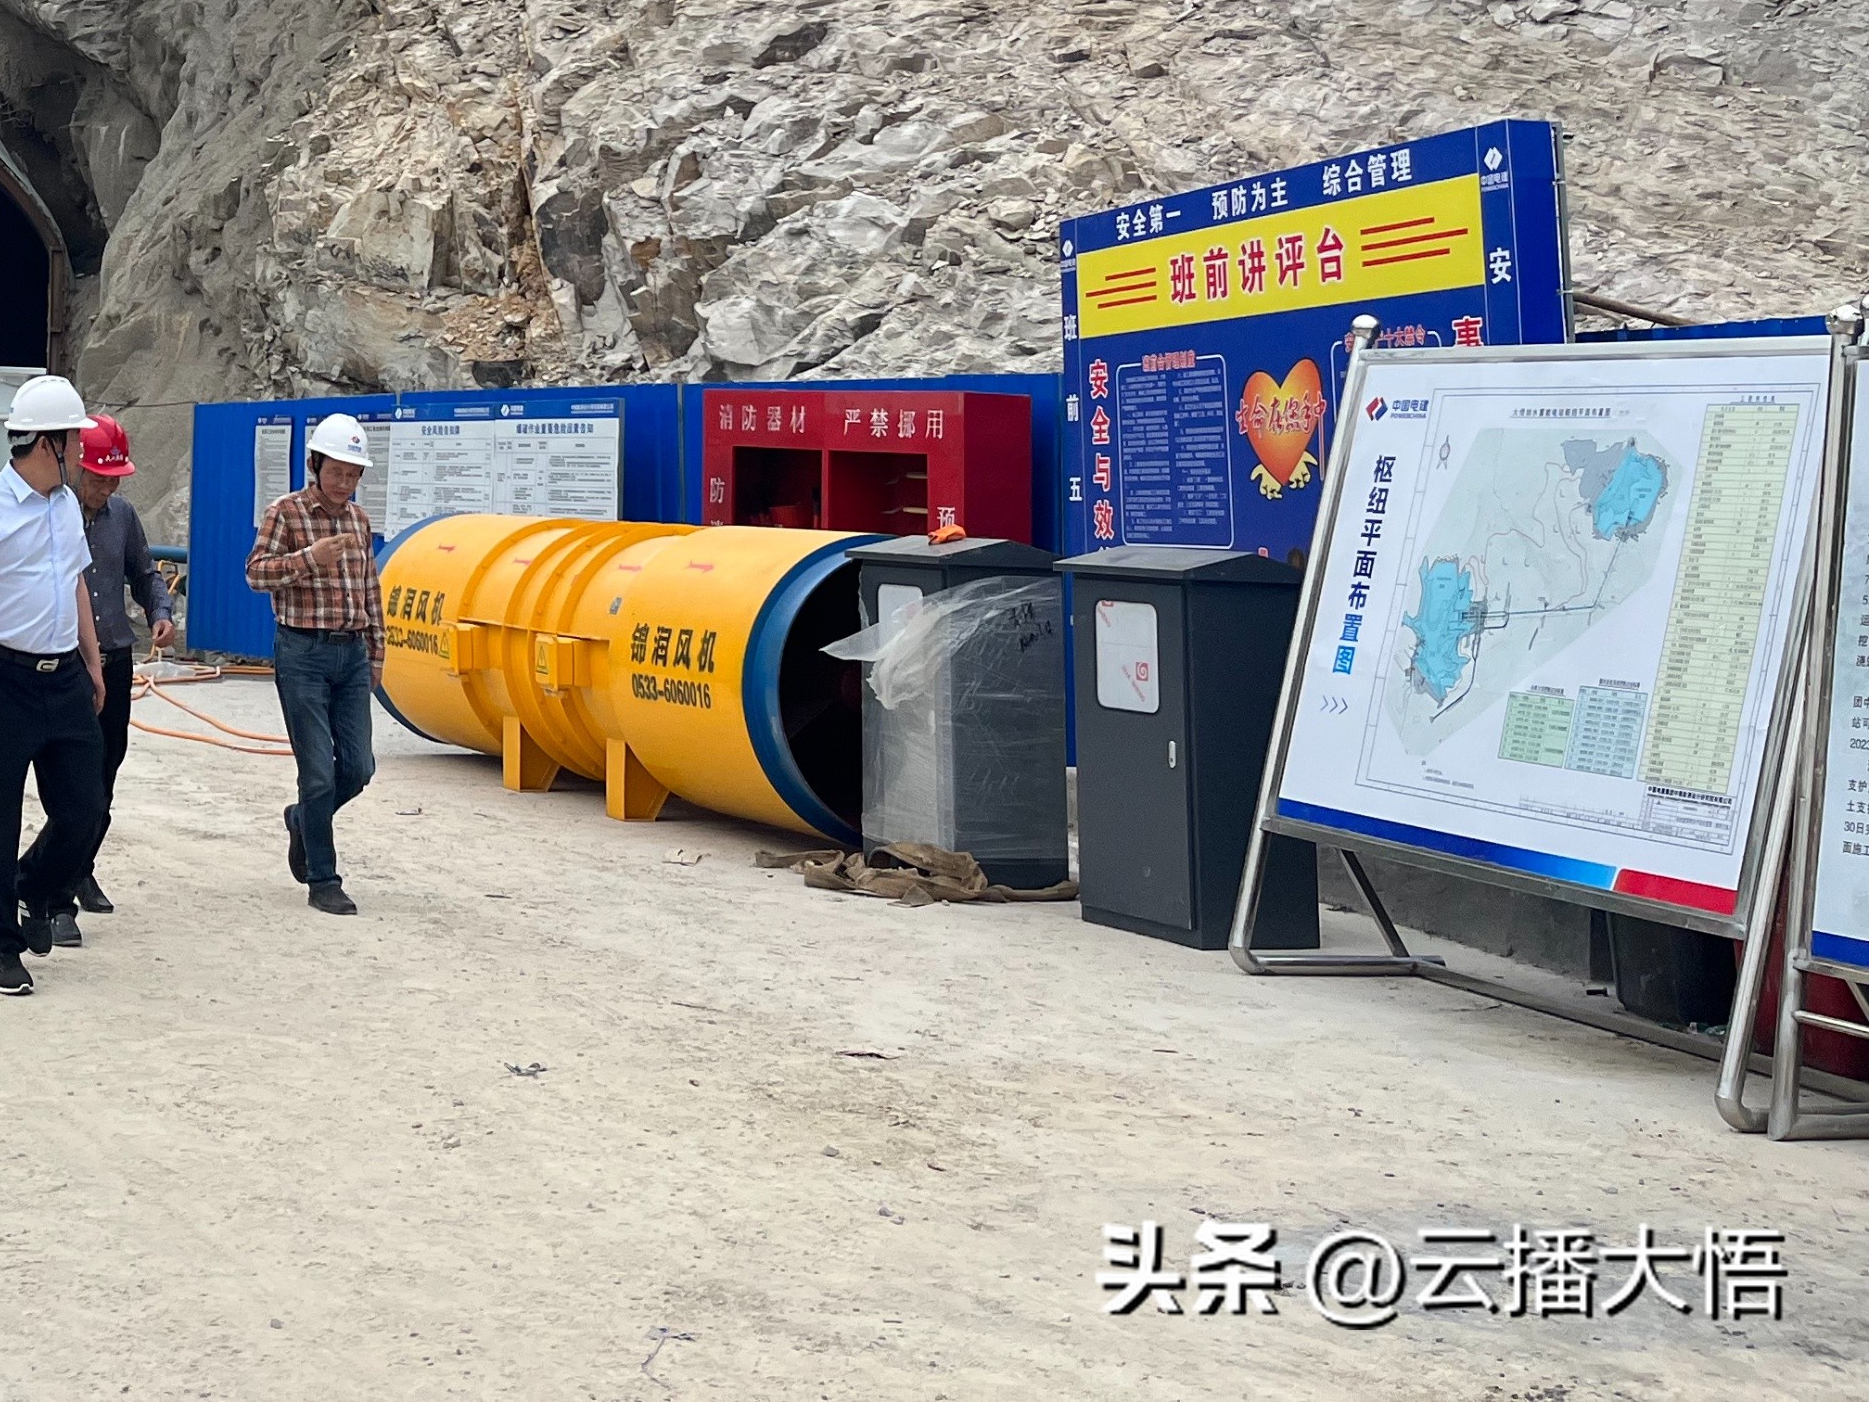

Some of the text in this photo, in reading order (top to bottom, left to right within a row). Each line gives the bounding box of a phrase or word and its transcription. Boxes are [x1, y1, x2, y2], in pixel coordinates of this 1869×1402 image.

[1116, 148, 1413, 241] 安全第一 预防为主 综合管理
[1168, 226, 1344, 304] 班前讲评台
[719, 403, 945, 439] 消防器材 严禁挪用
[1089, 358, 1115, 549] 安全与效
[1332, 454, 1397, 675] 枢纽平面布置图
[631, 673, 712, 709] 0533-6060016
